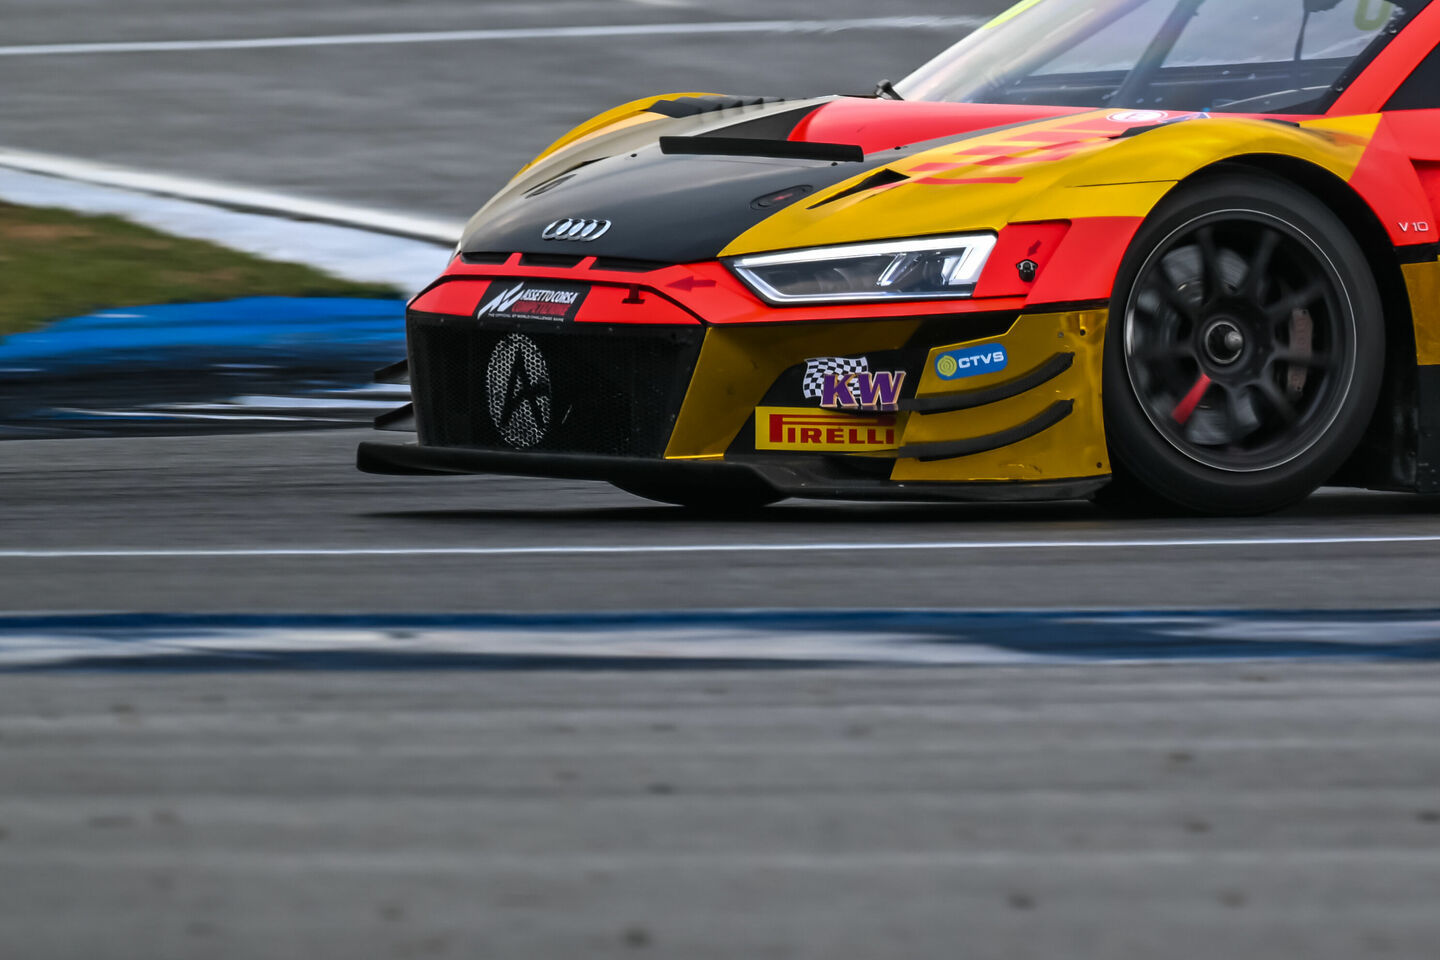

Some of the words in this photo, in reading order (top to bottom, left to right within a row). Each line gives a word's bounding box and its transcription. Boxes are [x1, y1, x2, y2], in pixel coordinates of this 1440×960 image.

[958, 351, 1005, 370] CTVS
[819, 371, 907, 408] KW
[768, 413, 897, 445] PIRELLI
